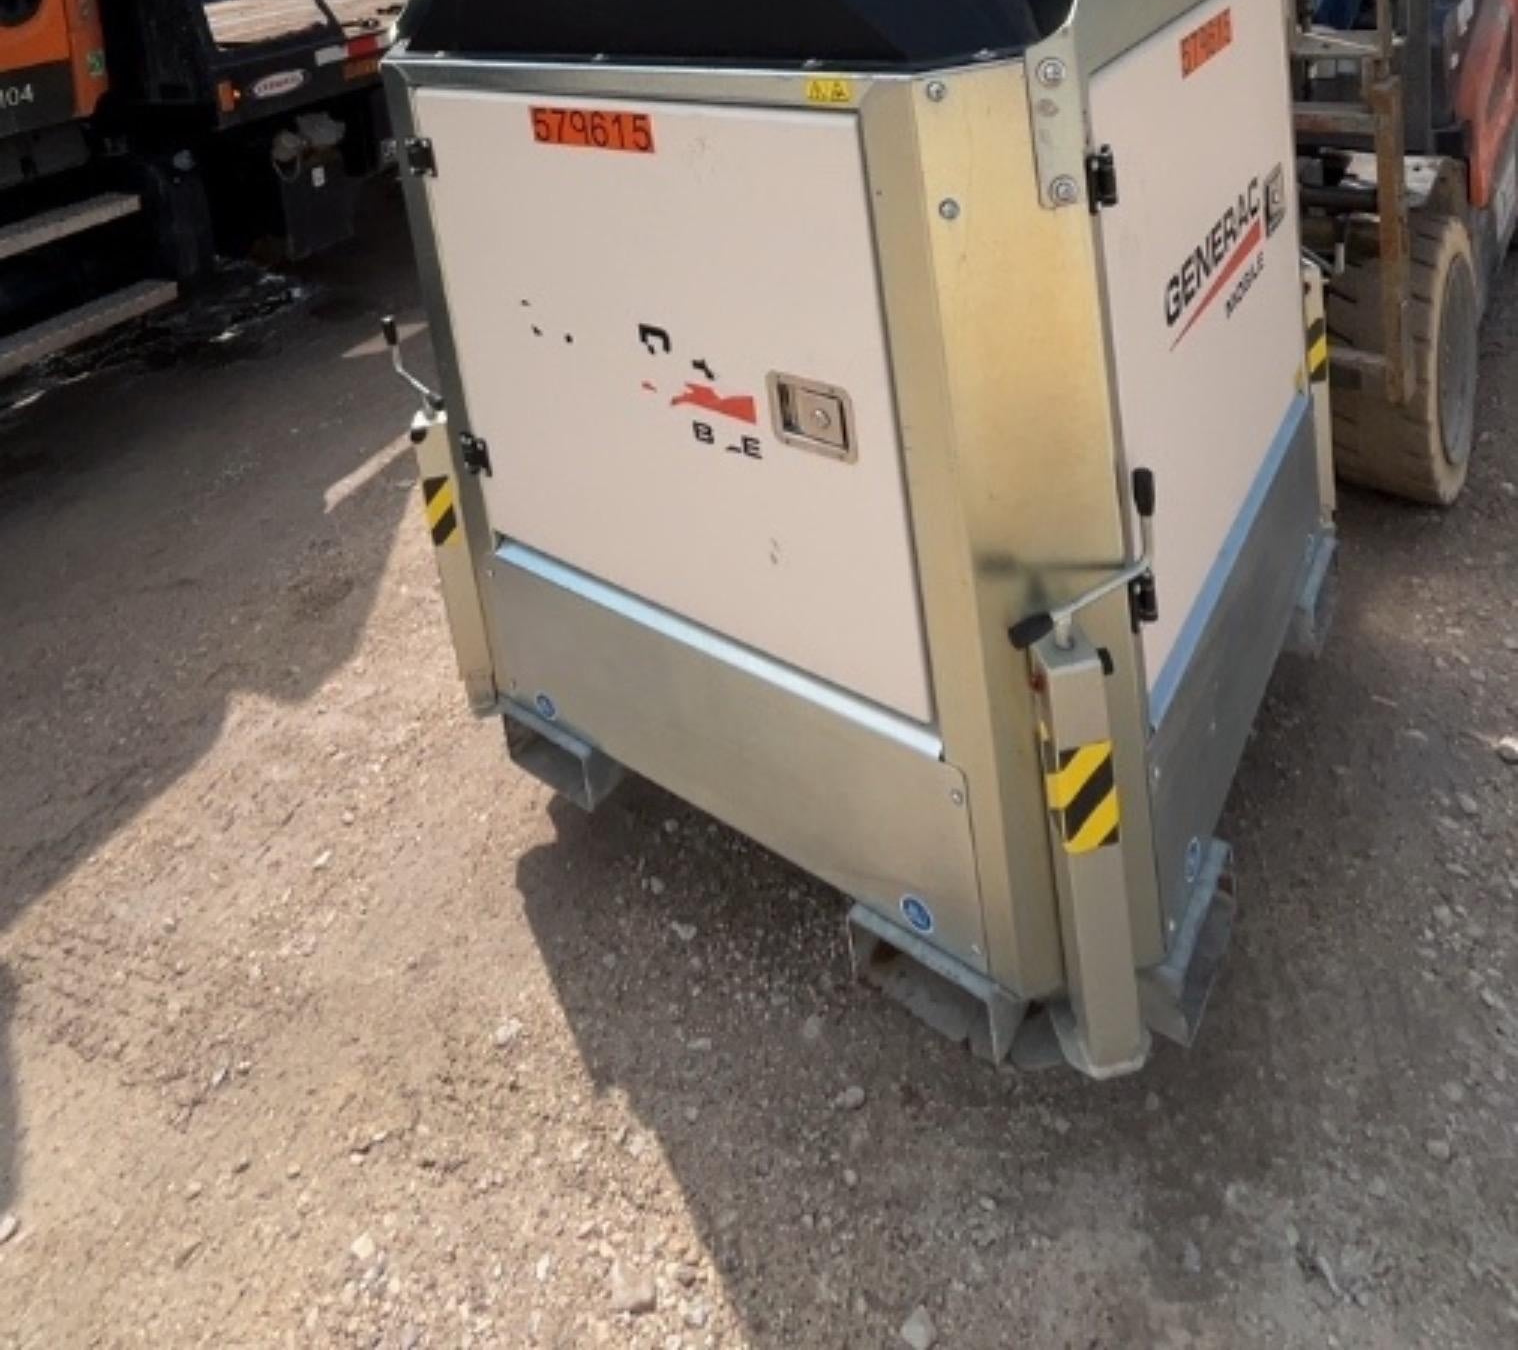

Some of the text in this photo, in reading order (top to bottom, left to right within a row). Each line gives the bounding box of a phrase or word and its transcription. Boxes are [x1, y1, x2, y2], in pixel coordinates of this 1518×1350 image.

[531, 107, 654, 152] 579615
[1164, 176, 1260, 328] GENERAC
[1225, 250, 1265, 319] MOBILE
